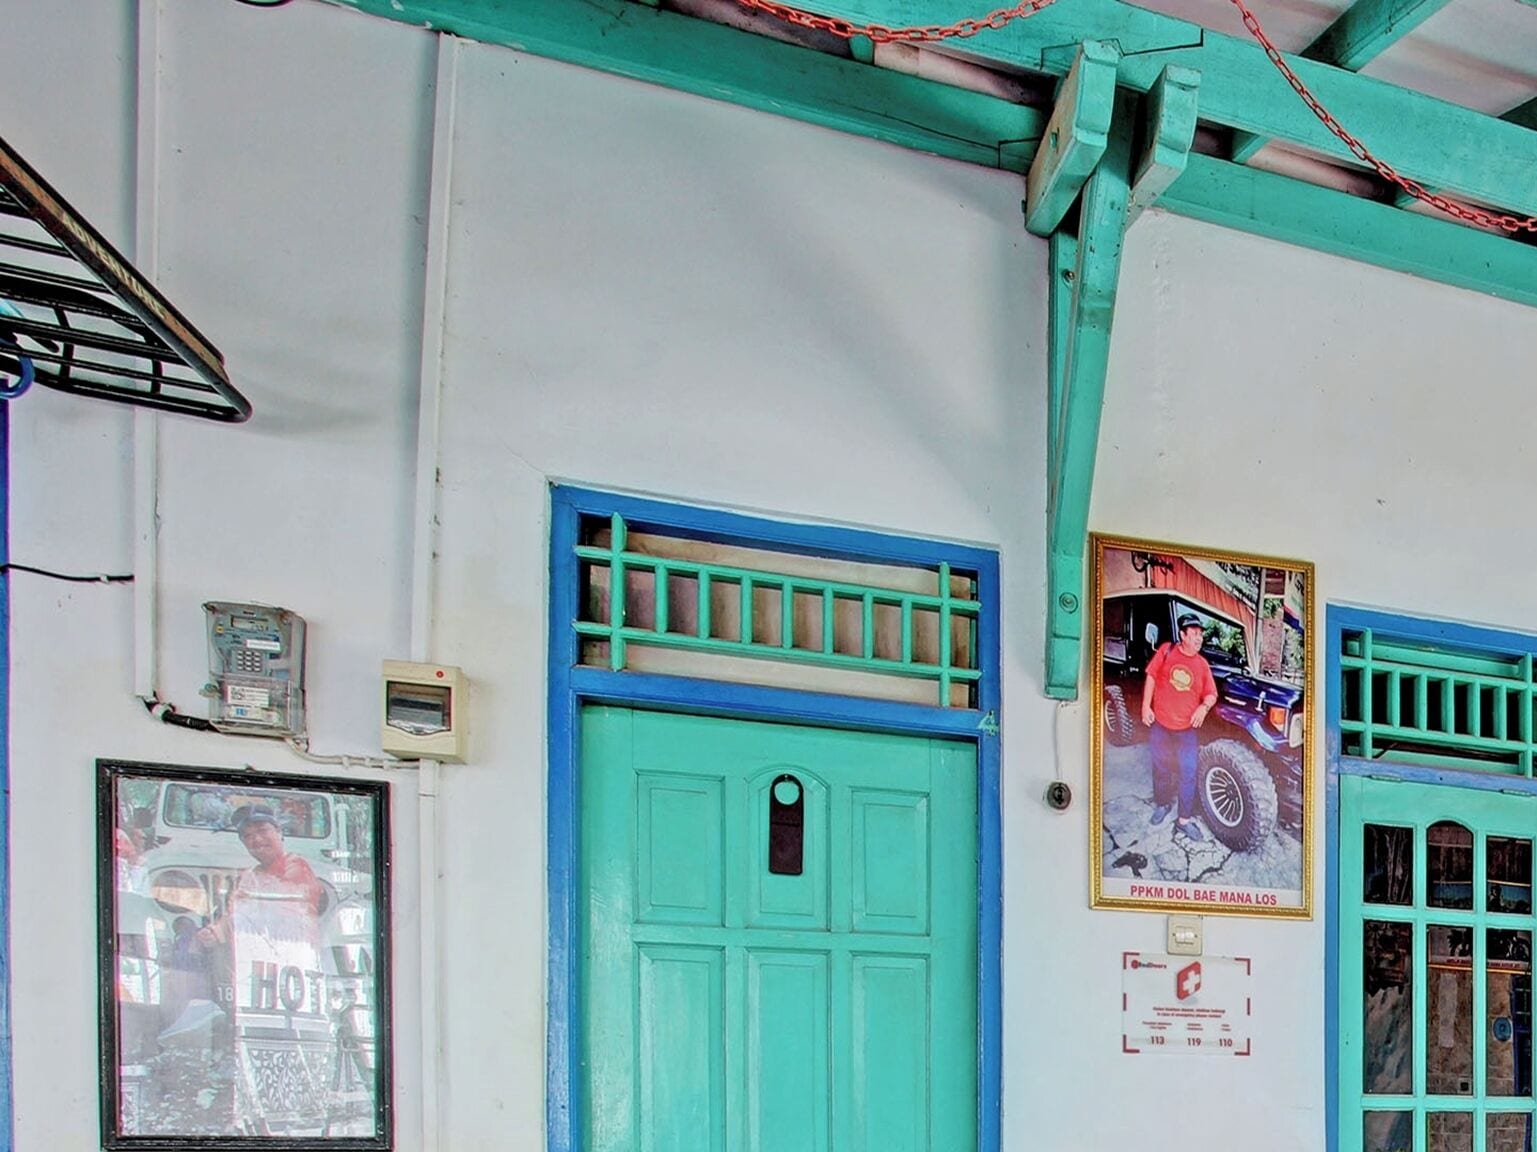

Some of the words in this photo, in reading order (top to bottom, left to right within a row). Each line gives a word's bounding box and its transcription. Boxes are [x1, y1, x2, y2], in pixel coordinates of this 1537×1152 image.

[1130, 885, 1164, 898] PPKM
[1167, 887, 1190, 900] DOL
[1193, 889, 1217, 901] BAE
[1219, 891, 1252, 904] MANA
[1255, 894, 1277, 905] LOS
[1151, 1035, 1165, 1045] 113
[1187, 1037, 1202, 1046] 119
[1219, 1038, 1233, 1047] 110
